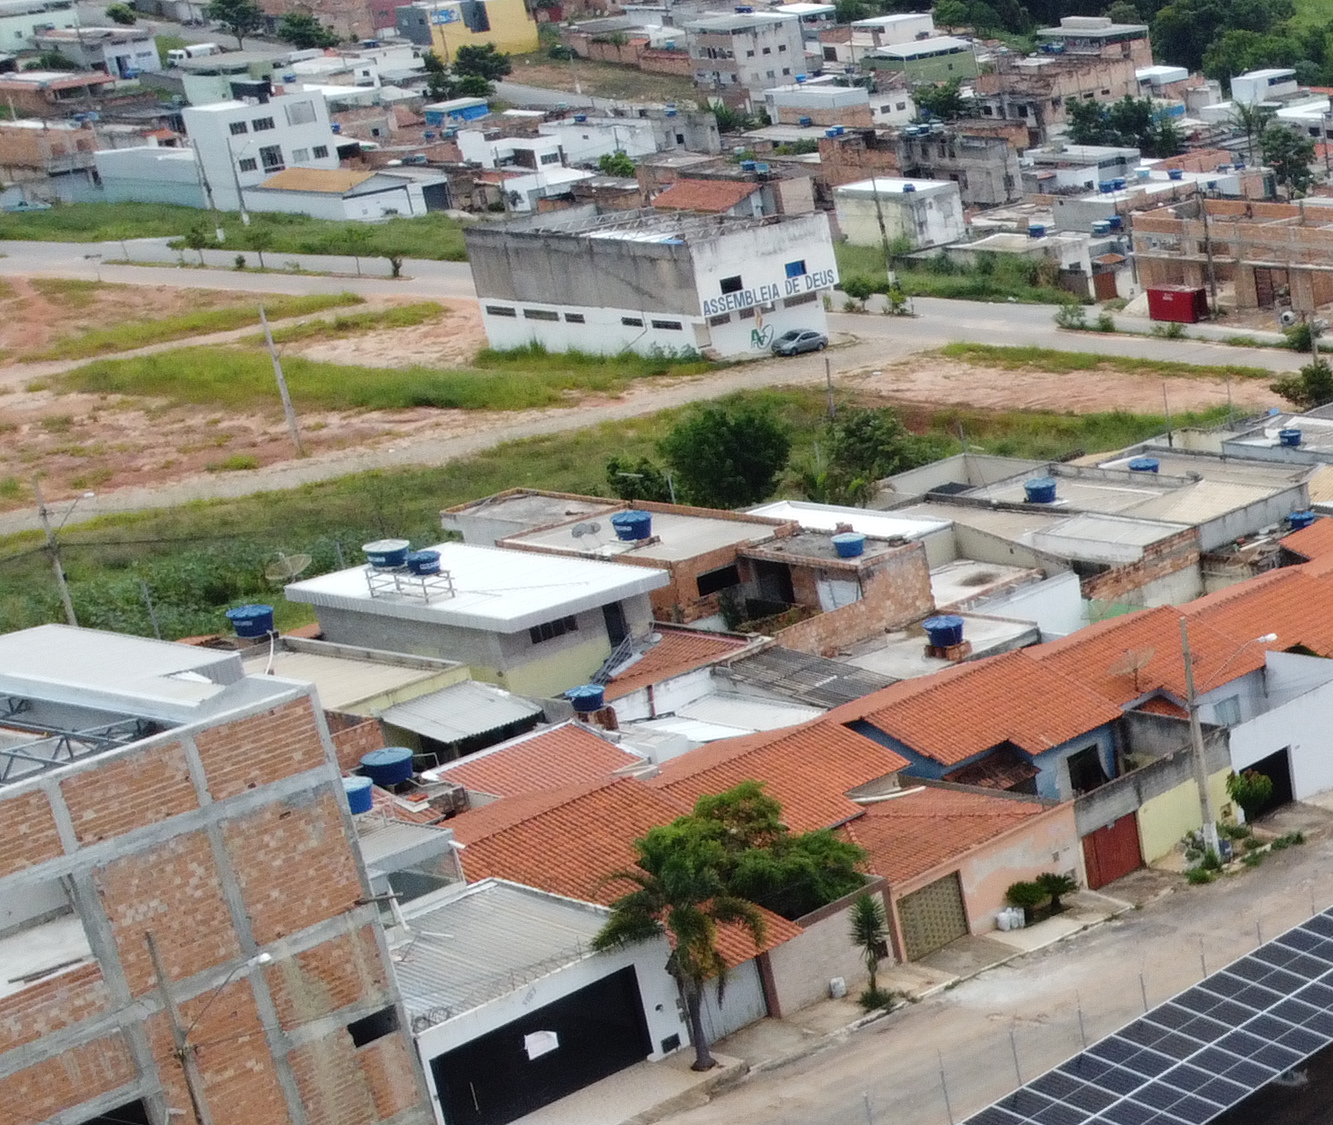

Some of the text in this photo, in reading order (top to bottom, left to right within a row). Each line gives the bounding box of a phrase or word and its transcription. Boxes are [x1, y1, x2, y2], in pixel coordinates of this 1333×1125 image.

[703, 269, 834, 317] ASSEMBLEIA DE DEUS
